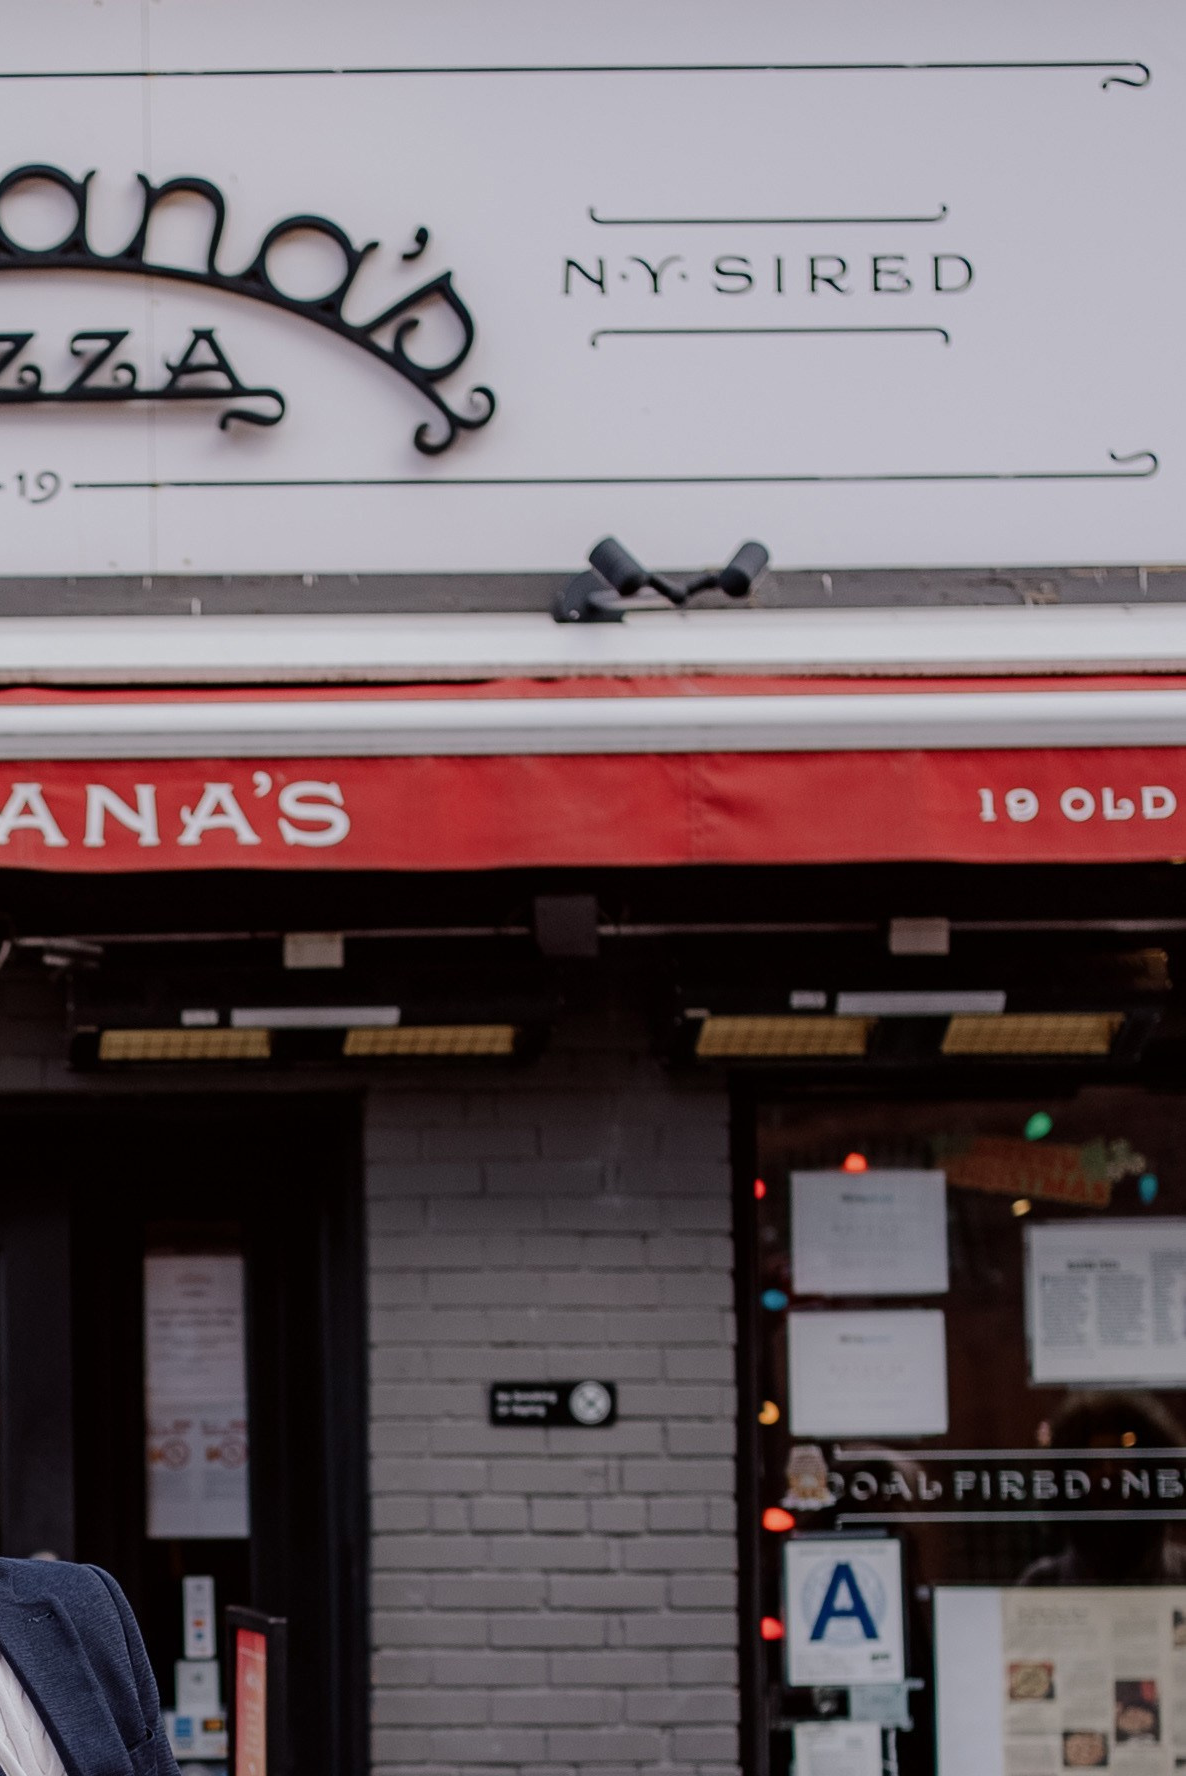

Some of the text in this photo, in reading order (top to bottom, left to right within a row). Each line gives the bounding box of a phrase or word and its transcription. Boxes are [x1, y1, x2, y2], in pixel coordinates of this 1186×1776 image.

[712, 253, 975, 295] SIRED
[16, 470, 62, 504] 19
[977, 785, 1178, 823] 19 OLD
[1121, 1468, 1186, 1500] NE
[810, 1562, 879, 1641] A
